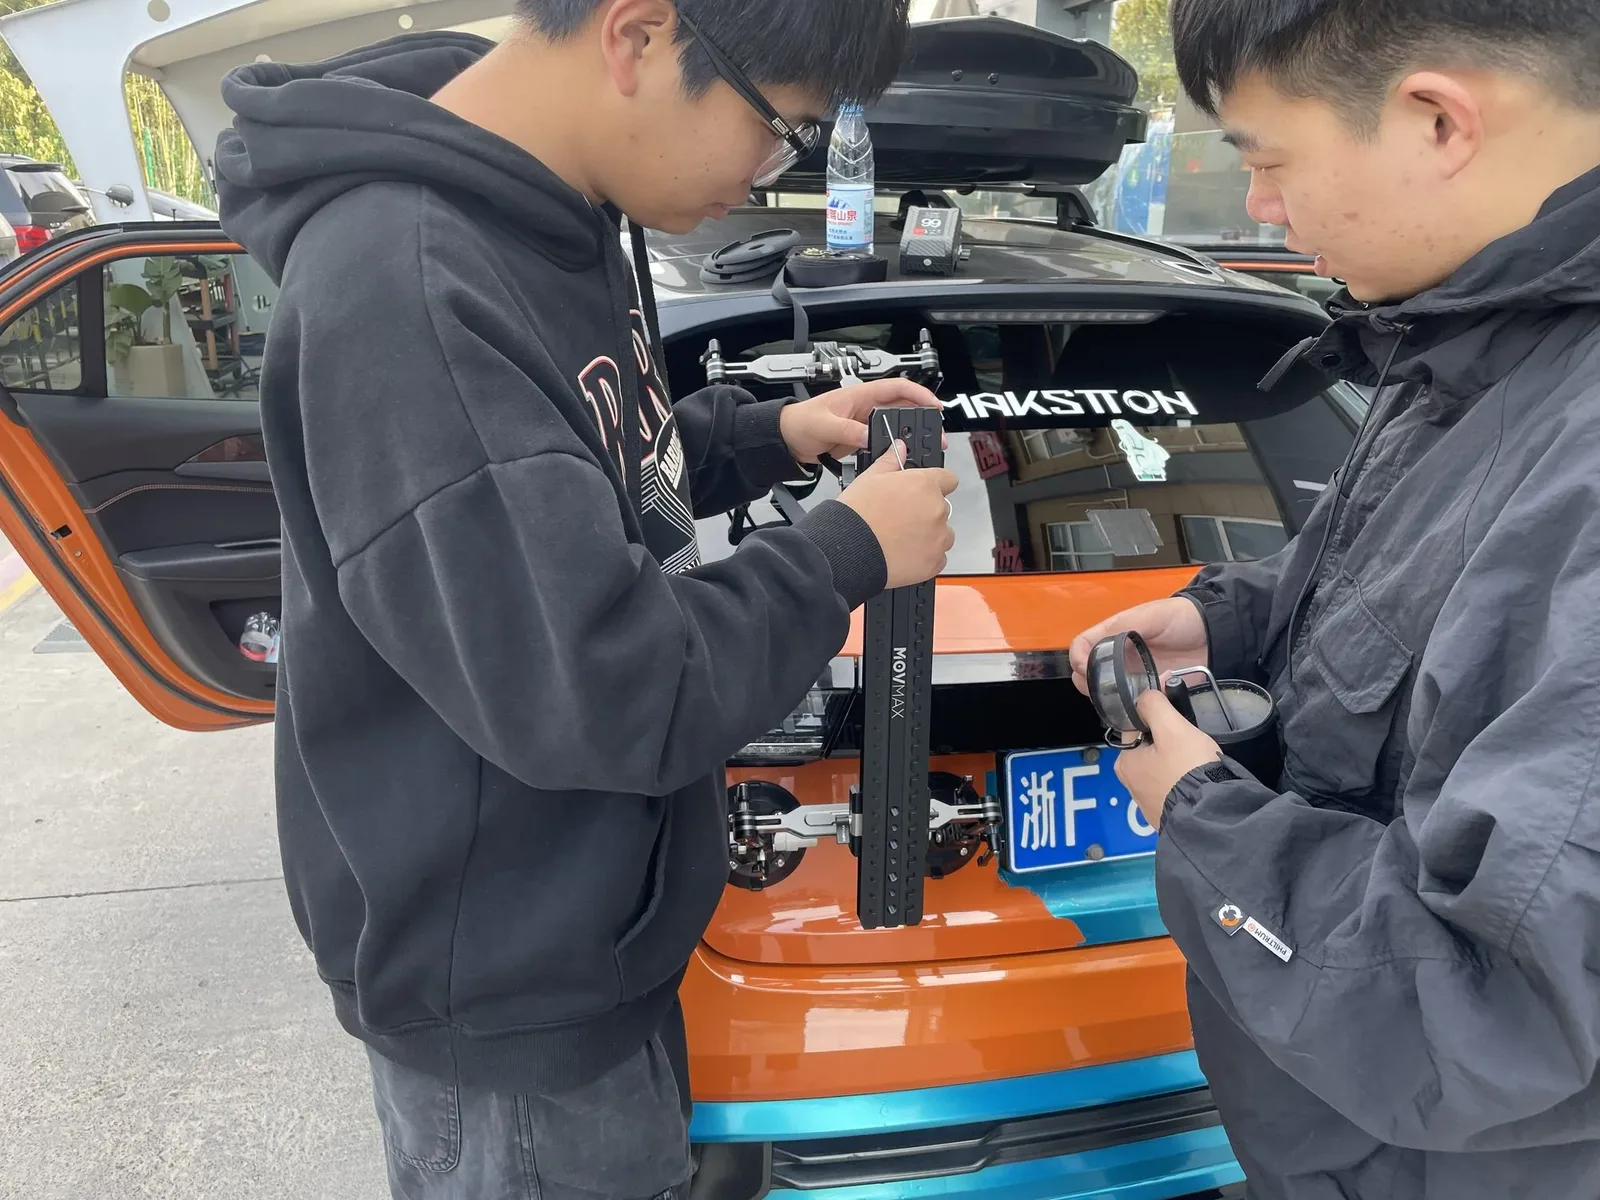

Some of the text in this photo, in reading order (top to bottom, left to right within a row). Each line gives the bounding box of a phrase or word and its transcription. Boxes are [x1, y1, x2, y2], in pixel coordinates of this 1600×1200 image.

[921, 218, 942, 228] 99
[891, 647, 907, 719] MOVMAX
[1254, 928, 1287, 956] PHILTRUM
